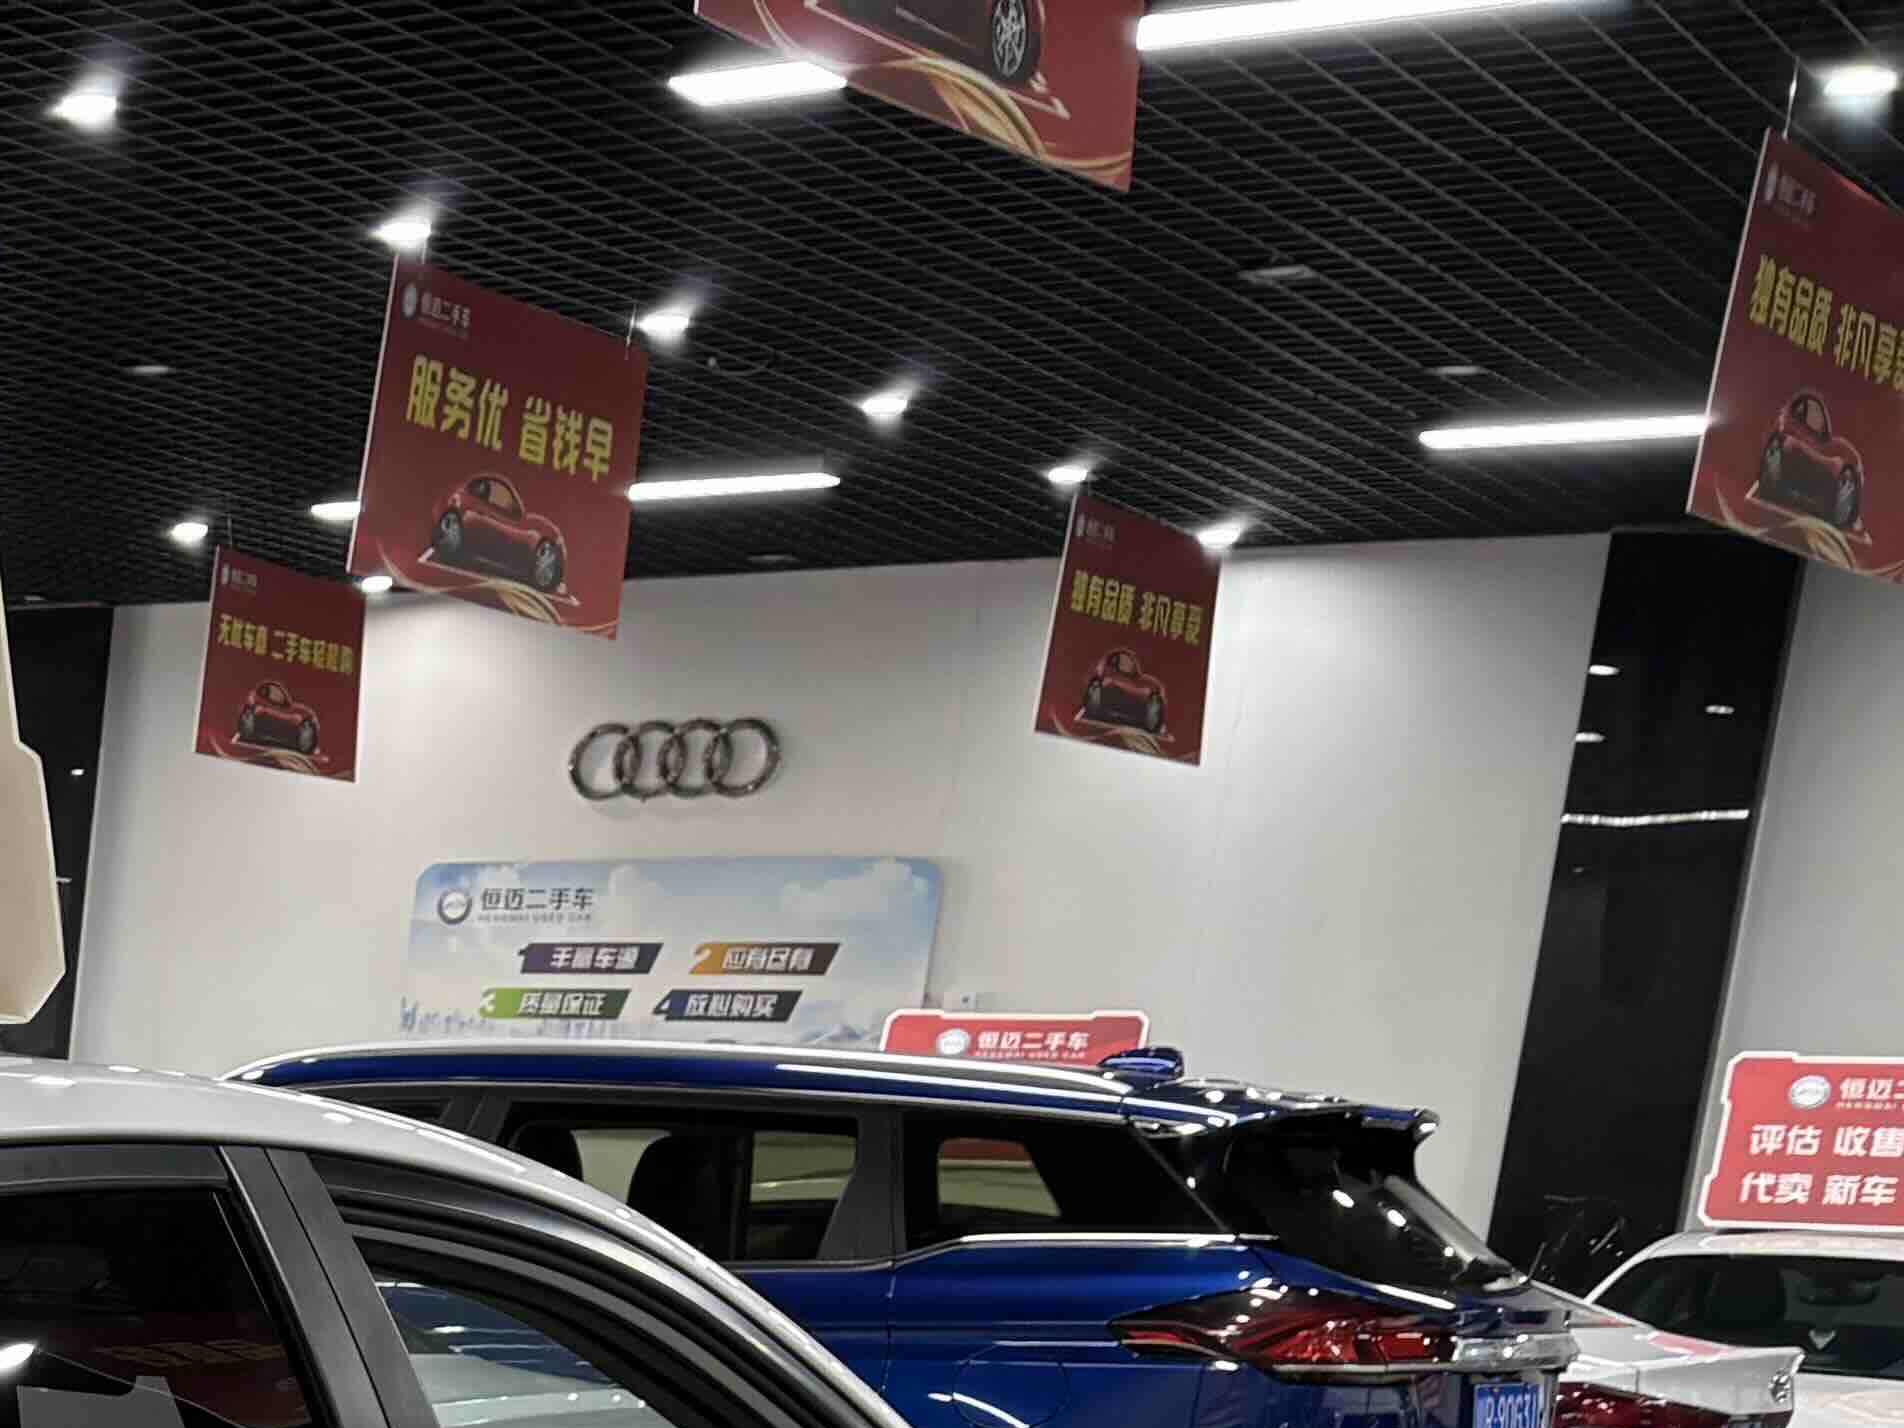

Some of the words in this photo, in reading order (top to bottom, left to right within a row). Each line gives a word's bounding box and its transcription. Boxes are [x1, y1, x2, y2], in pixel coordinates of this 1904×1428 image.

[406, 354, 508, 450] 服务优
[519, 396, 613, 482] 省钱早
[481, 888, 593, 910] 恒迈二手车
[977, 1031, 1089, 1051] 恒迈二手车
[1749, 1124, 1822, 1156] 评估
[1833, 1127, 1904, 1157] 收售
[1740, 1172, 1813, 1204] 代卖
[1822, 1174, 1898, 1206] 新车
